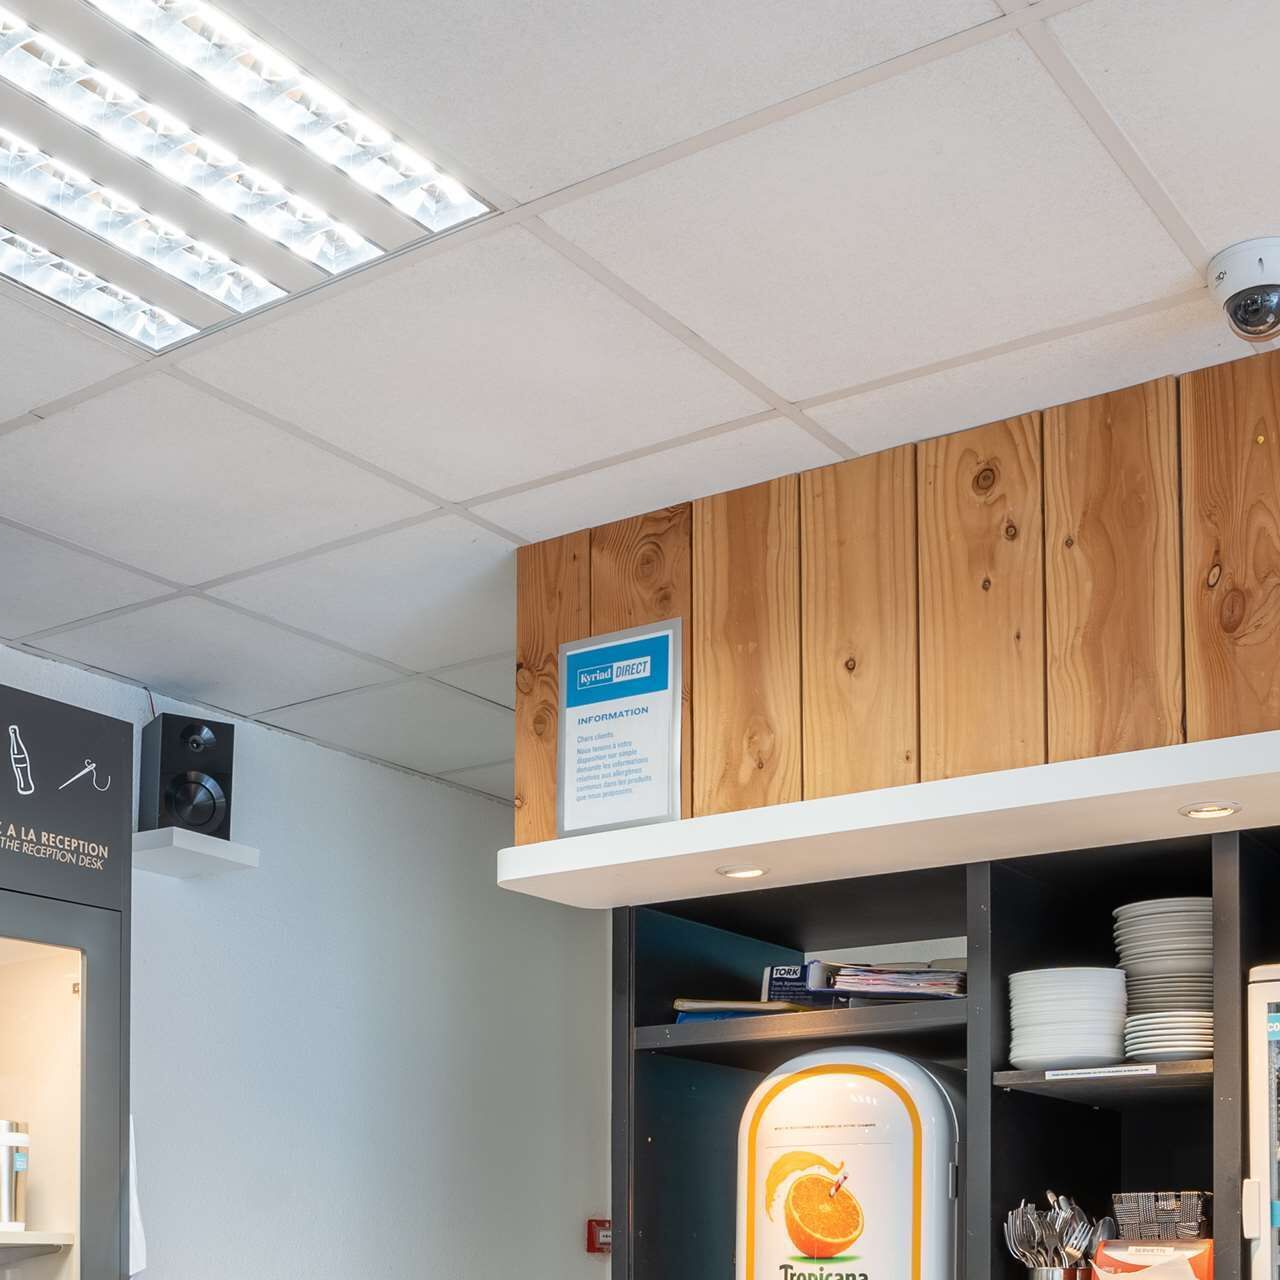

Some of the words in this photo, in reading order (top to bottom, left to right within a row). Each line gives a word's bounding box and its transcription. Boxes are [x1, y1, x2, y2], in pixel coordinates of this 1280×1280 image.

[581, 667, 612, 686] Kyriad
[615, 661, 649, 678] DIRECT
[577, 706, 649, 725] INFORMATION
[0, 836, 20, 852] THE
[22, 842, 76, 865] RECEPTION
[79, 855, 104, 871] DESK
[7, 824, 17, 838] A
[21, 827, 36, 842] LA
[41, 831, 108, 859] RECEPTION
[774, 967, 799, 976] TORK
